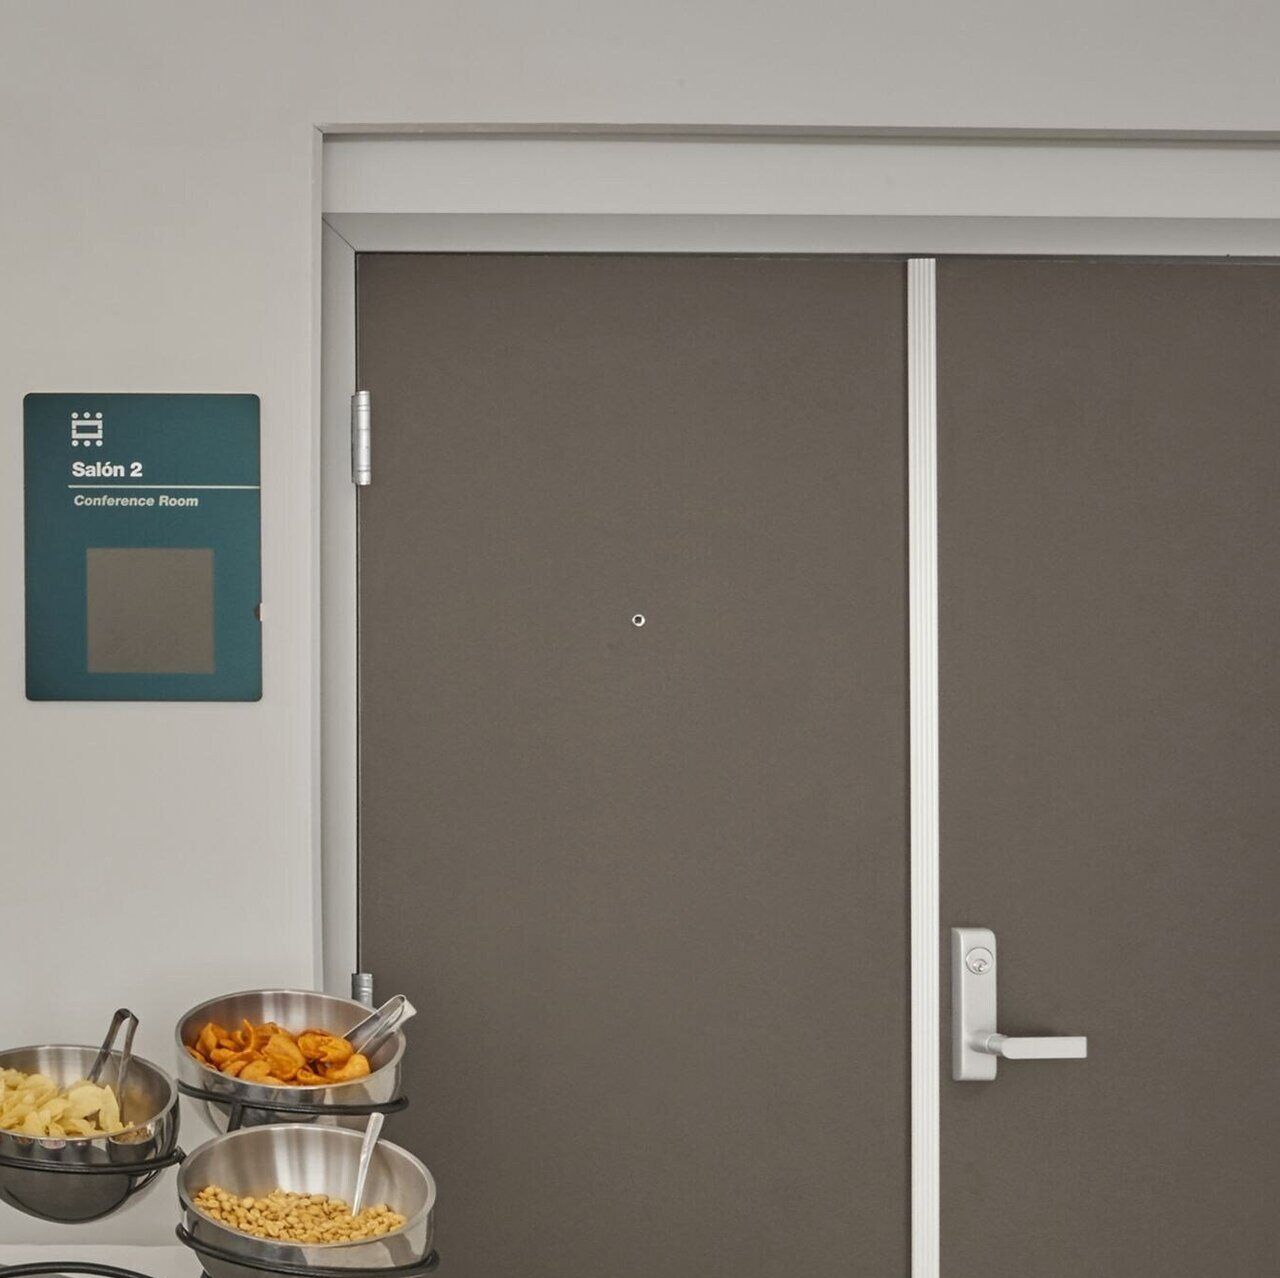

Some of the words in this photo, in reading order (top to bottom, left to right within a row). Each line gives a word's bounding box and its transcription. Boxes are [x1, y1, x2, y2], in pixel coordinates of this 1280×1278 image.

[72, 461, 125, 477] Salón
[130, 461, 143, 477] 2
[73, 494, 155, 507] Conference
[159, 495, 199, 507] Room
